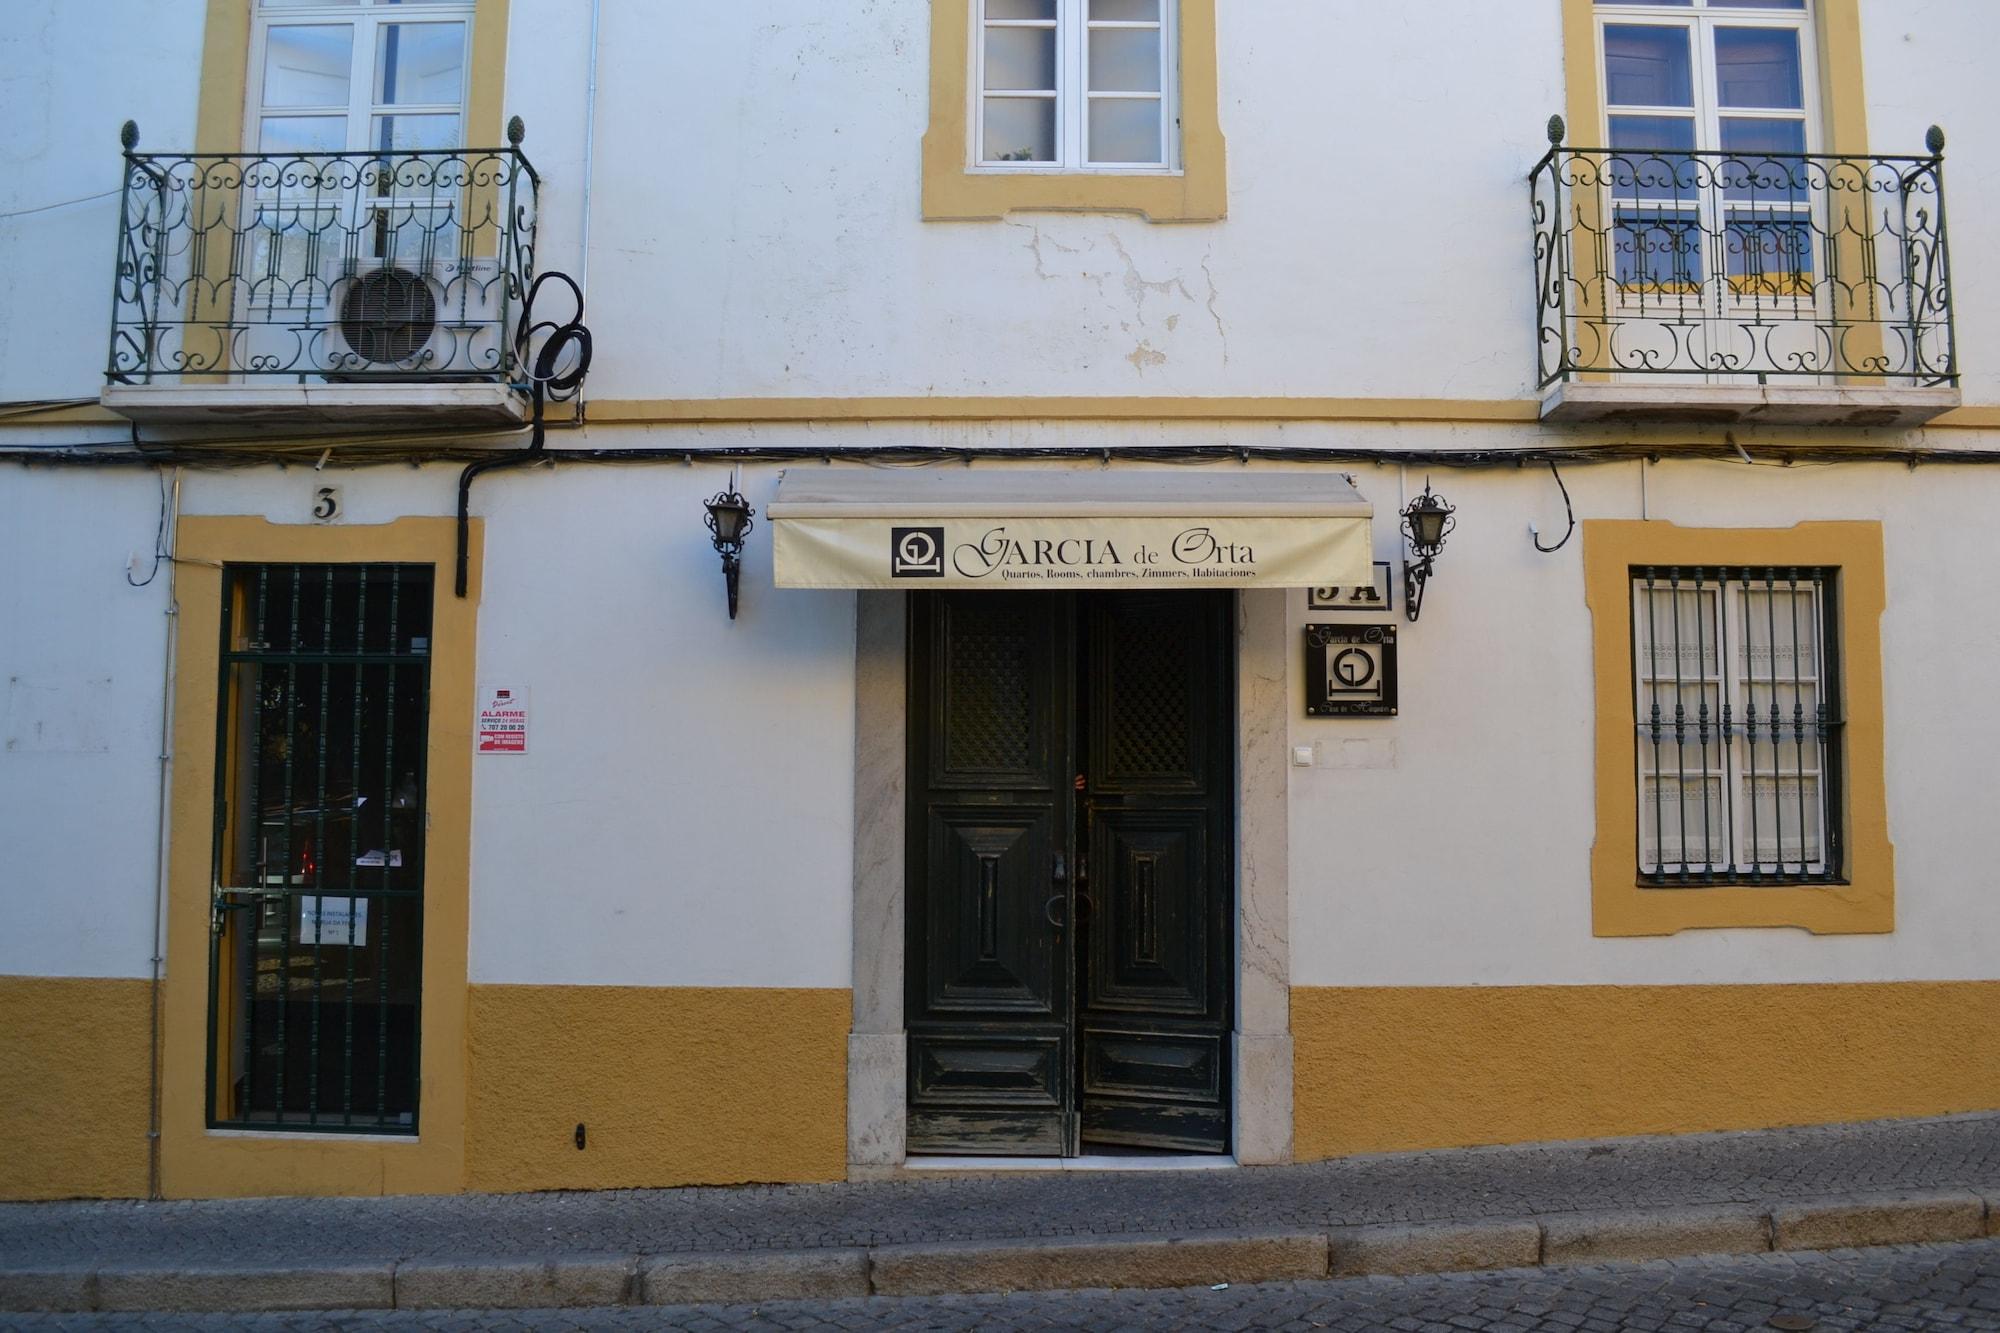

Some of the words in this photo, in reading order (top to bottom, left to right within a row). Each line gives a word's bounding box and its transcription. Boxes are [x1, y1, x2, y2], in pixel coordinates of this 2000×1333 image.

[313, 487, 336, 519] 3
[952, 527, 1122, 578] GARCIA
[1133, 545, 1159, 564] de
[1171, 527, 1257, 565] Orta
[1001, 569, 1043, 580] Quartos,
[1047, 569, 1083, 579] Rooms,
[1086, 568, 1139, 579] chambres,
[1141, 568, 1189, 579] Zimmers,
[1192, 567, 1257, 578] Habitaciones
